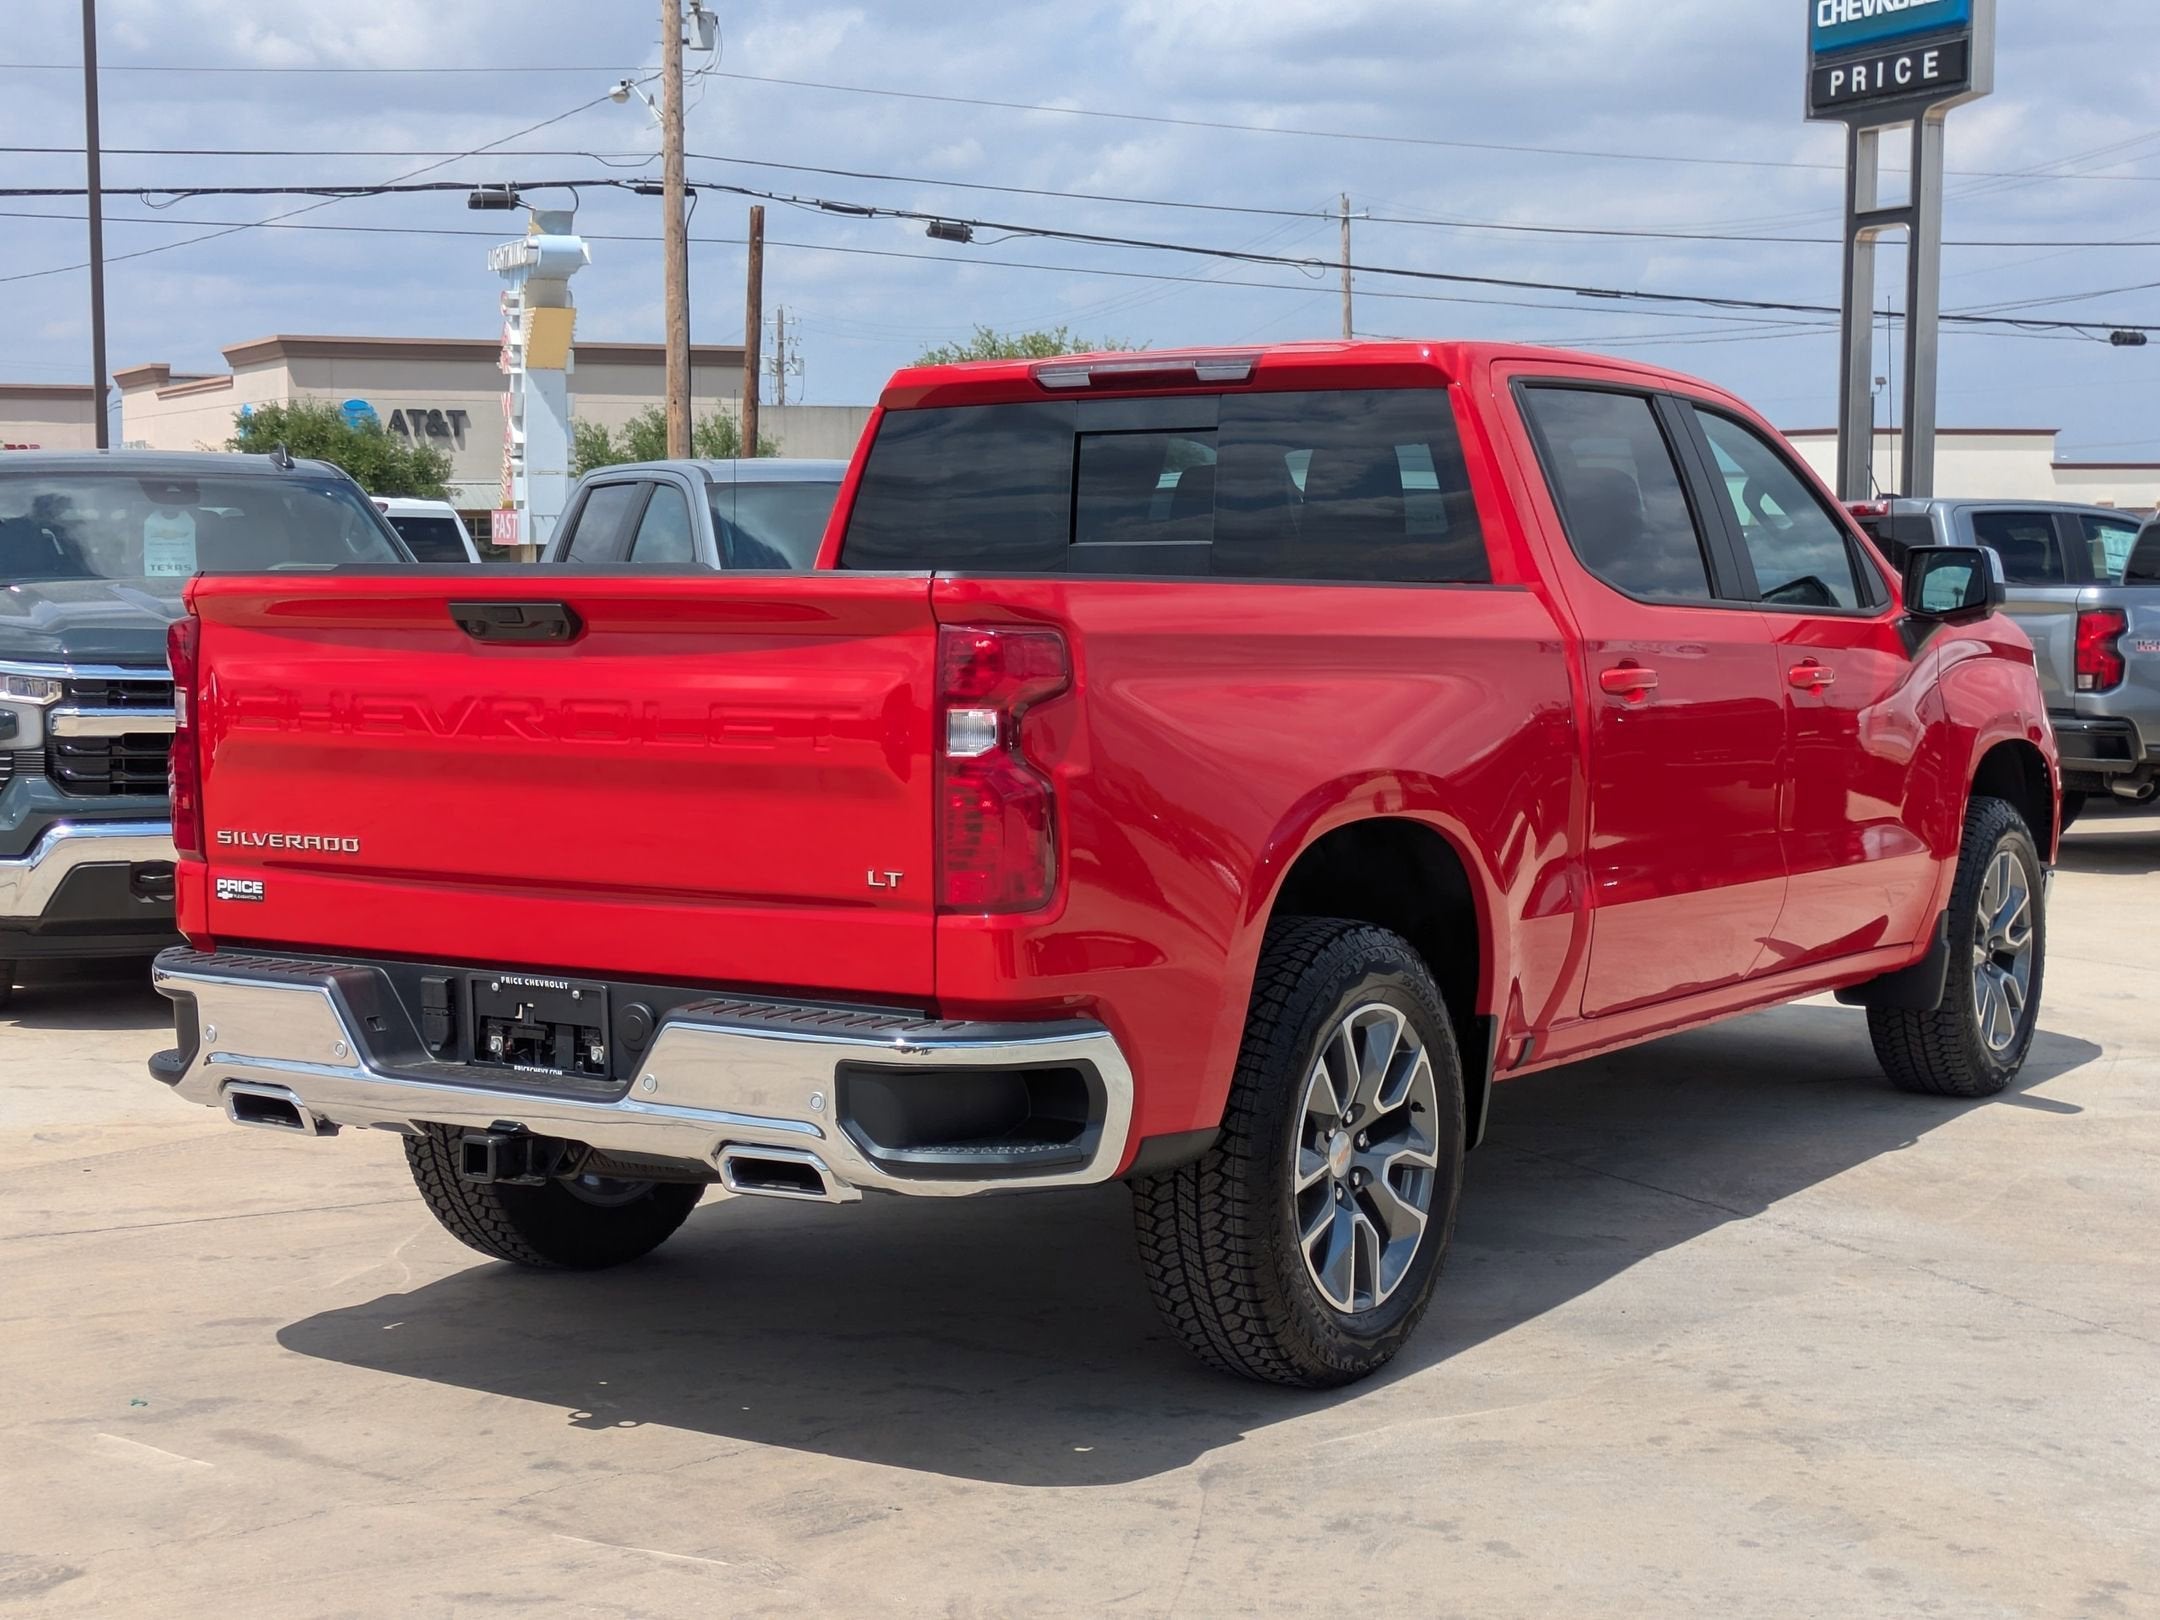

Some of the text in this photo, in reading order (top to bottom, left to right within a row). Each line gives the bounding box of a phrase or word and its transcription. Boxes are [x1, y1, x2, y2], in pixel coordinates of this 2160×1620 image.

[1830, 50, 1940, 97] PRICE
[488, 240, 528, 271] LIGHTNING
[386, 408, 467, 437] AT&T
[493, 513, 518, 540] FAST
[150, 563, 192, 572] TEXAS
[216, 830, 360, 852] SILVERADO
[216, 878, 264, 894] PRICE
[867, 869, 904, 888] LT
[500, 976, 569, 990] PRICE CHEVROLET
